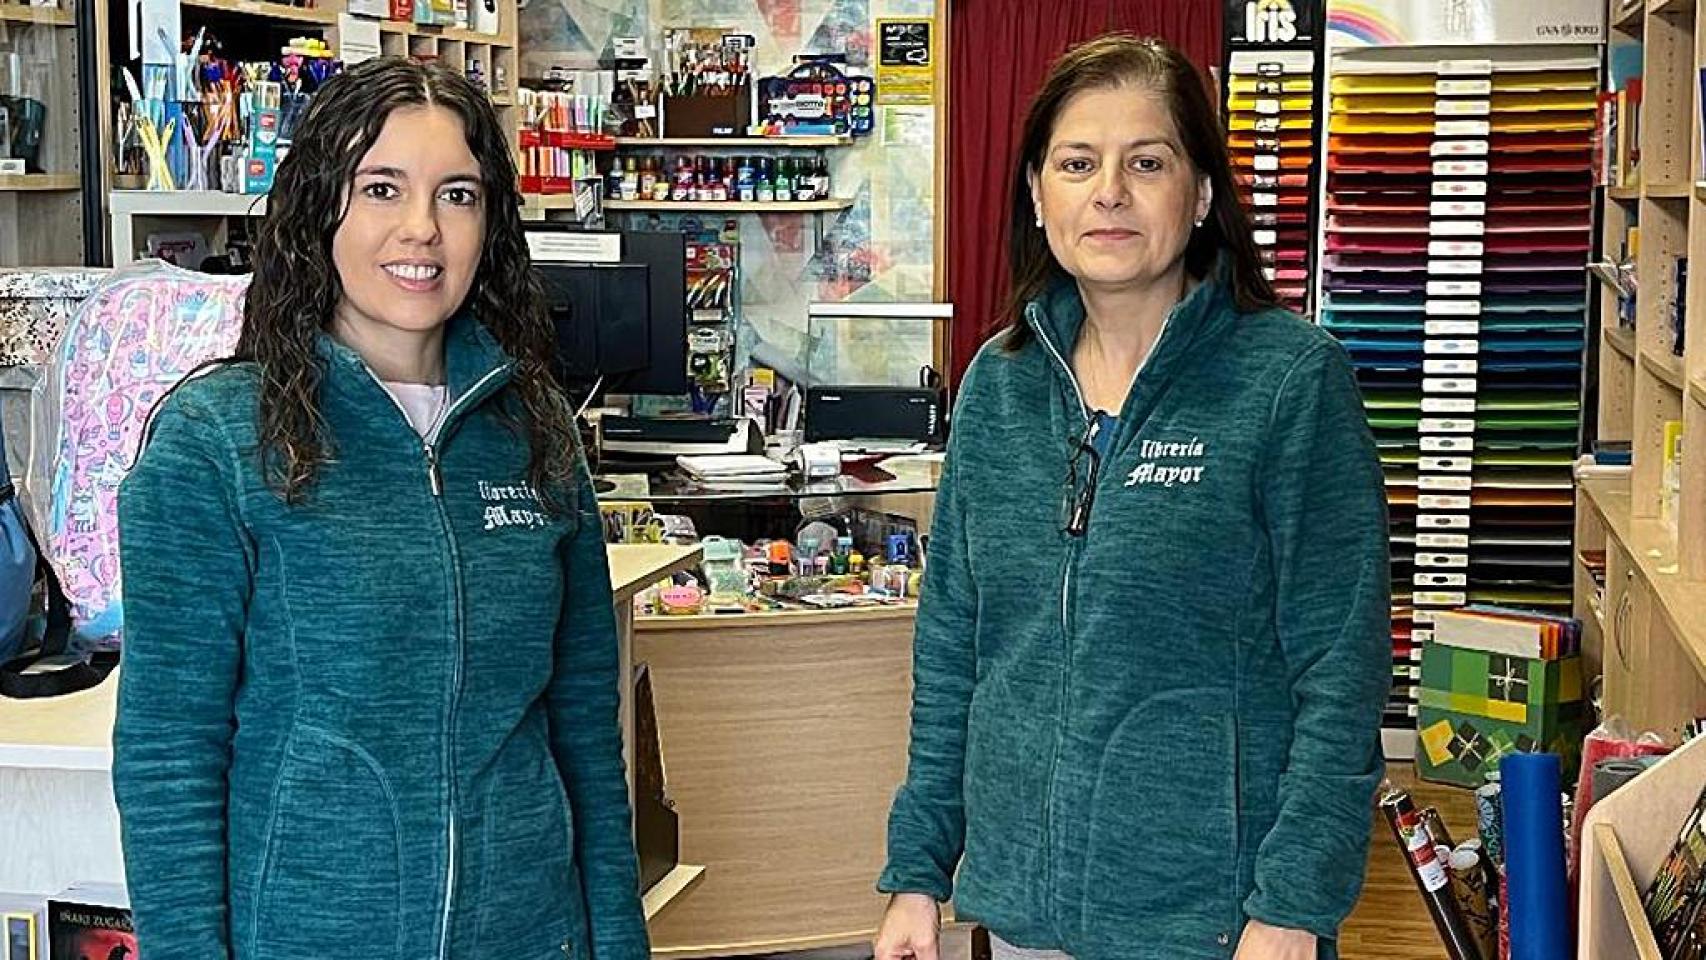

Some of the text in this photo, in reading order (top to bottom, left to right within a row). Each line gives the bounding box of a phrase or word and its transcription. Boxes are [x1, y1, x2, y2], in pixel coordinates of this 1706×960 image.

[1246, 2, 1297, 42] Iris
[1124, 463, 1204, 487] Mayor
[483, 505, 551, 530] May
